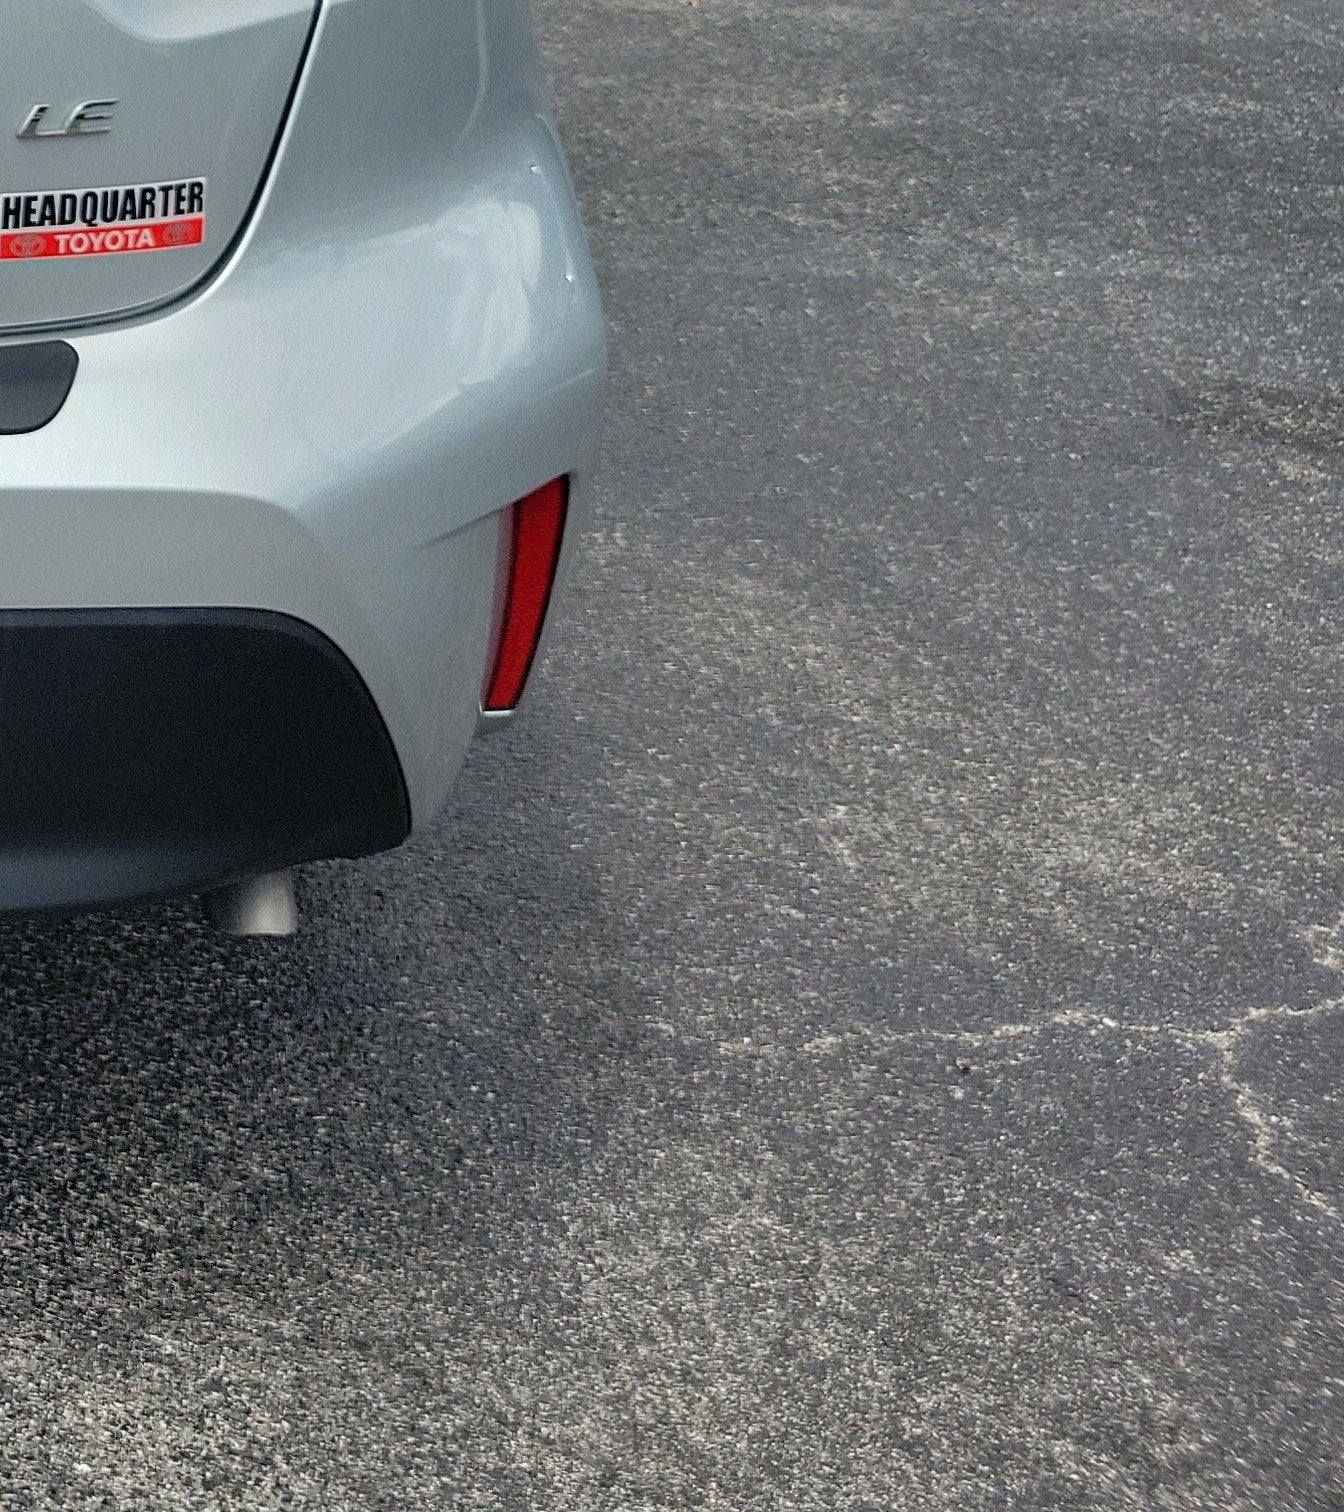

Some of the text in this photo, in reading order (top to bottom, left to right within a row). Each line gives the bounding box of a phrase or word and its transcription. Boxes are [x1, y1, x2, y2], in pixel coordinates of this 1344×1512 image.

[15, 97, 119, 140] LE
[1, 180, 204, 230] HEADQUARTER
[54, 227, 156, 255] TOYOTA
